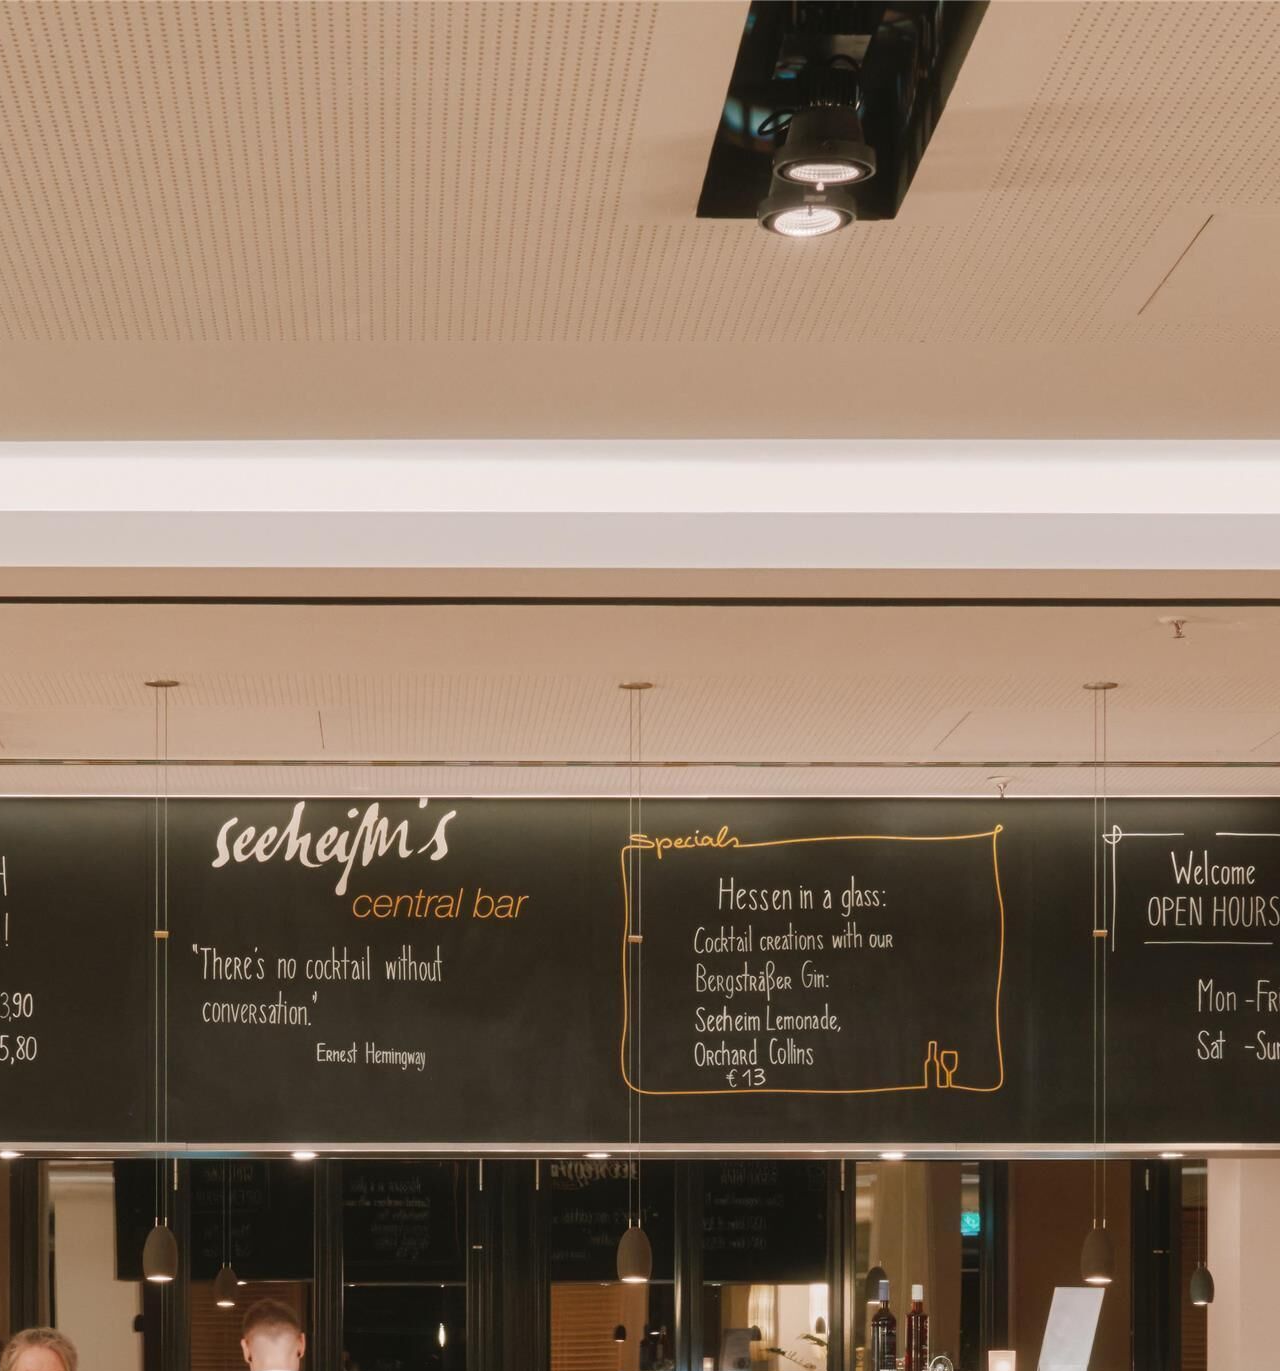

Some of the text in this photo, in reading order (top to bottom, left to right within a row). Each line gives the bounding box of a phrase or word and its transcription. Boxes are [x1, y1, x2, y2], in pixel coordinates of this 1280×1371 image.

[629, 825, 741, 860] Specials
[1170, 849, 1256, 886] Welcome
[352, 887, 530, 919] central bar
[718, 875, 887, 918] Hessen in a glass:
[1147, 895, 1280, 928] OPEN HOURS
[693, 921, 894, 954] Cocktail creations with our
[277, 958, 297, 980] no
[305, 945, 371, 981] cocktail
[385, 944, 443, 982] without
[801, 959, 830, 989] Gin:
[0, 991, 34, 1022] 3,90
[694, 1002, 842, 1033] Seeheim Lemonade,
[316, 1041, 426, 1072] Ernest Hemingway
[694, 1037, 814, 1067] Orchard Collins
